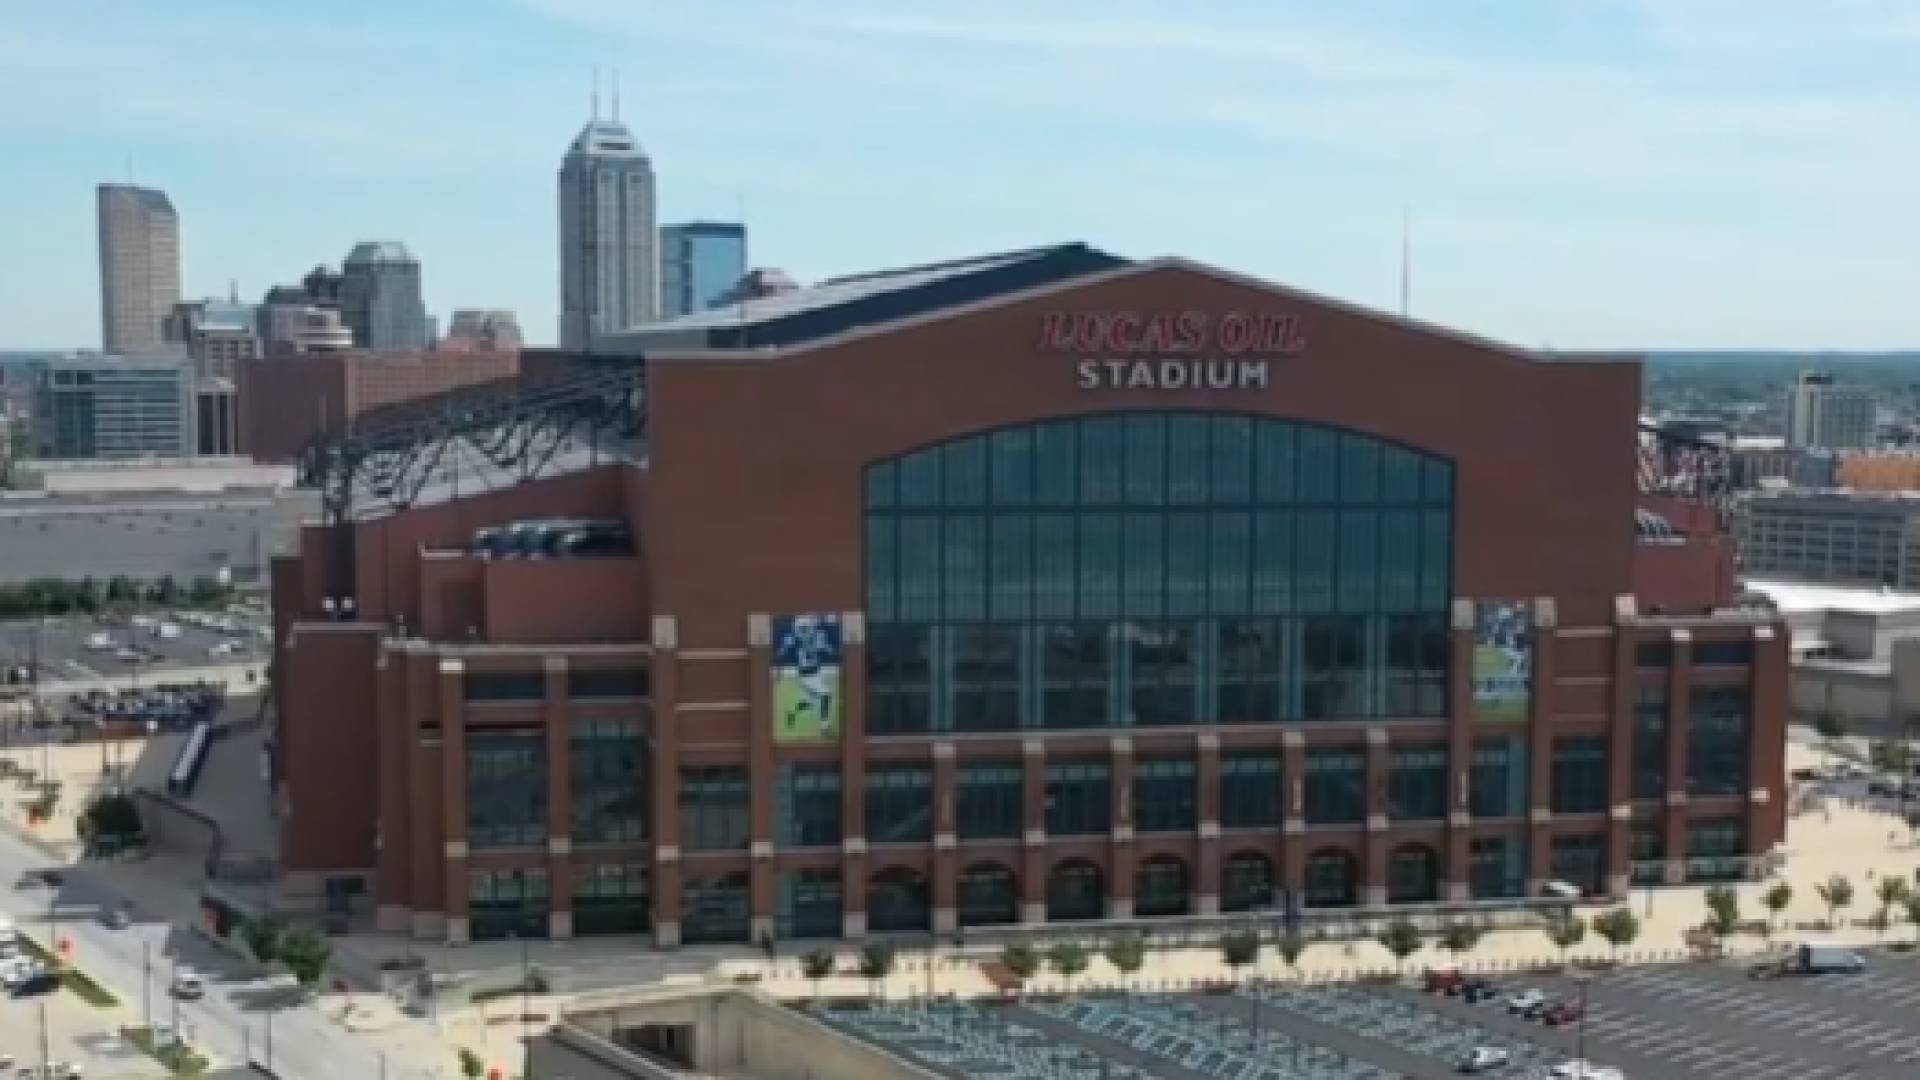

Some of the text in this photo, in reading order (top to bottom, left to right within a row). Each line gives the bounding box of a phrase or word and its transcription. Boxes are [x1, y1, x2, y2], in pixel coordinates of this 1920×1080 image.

[1038, 311, 1305, 352] LUCAS OIL
[1076, 358, 1269, 388] STADIUM
